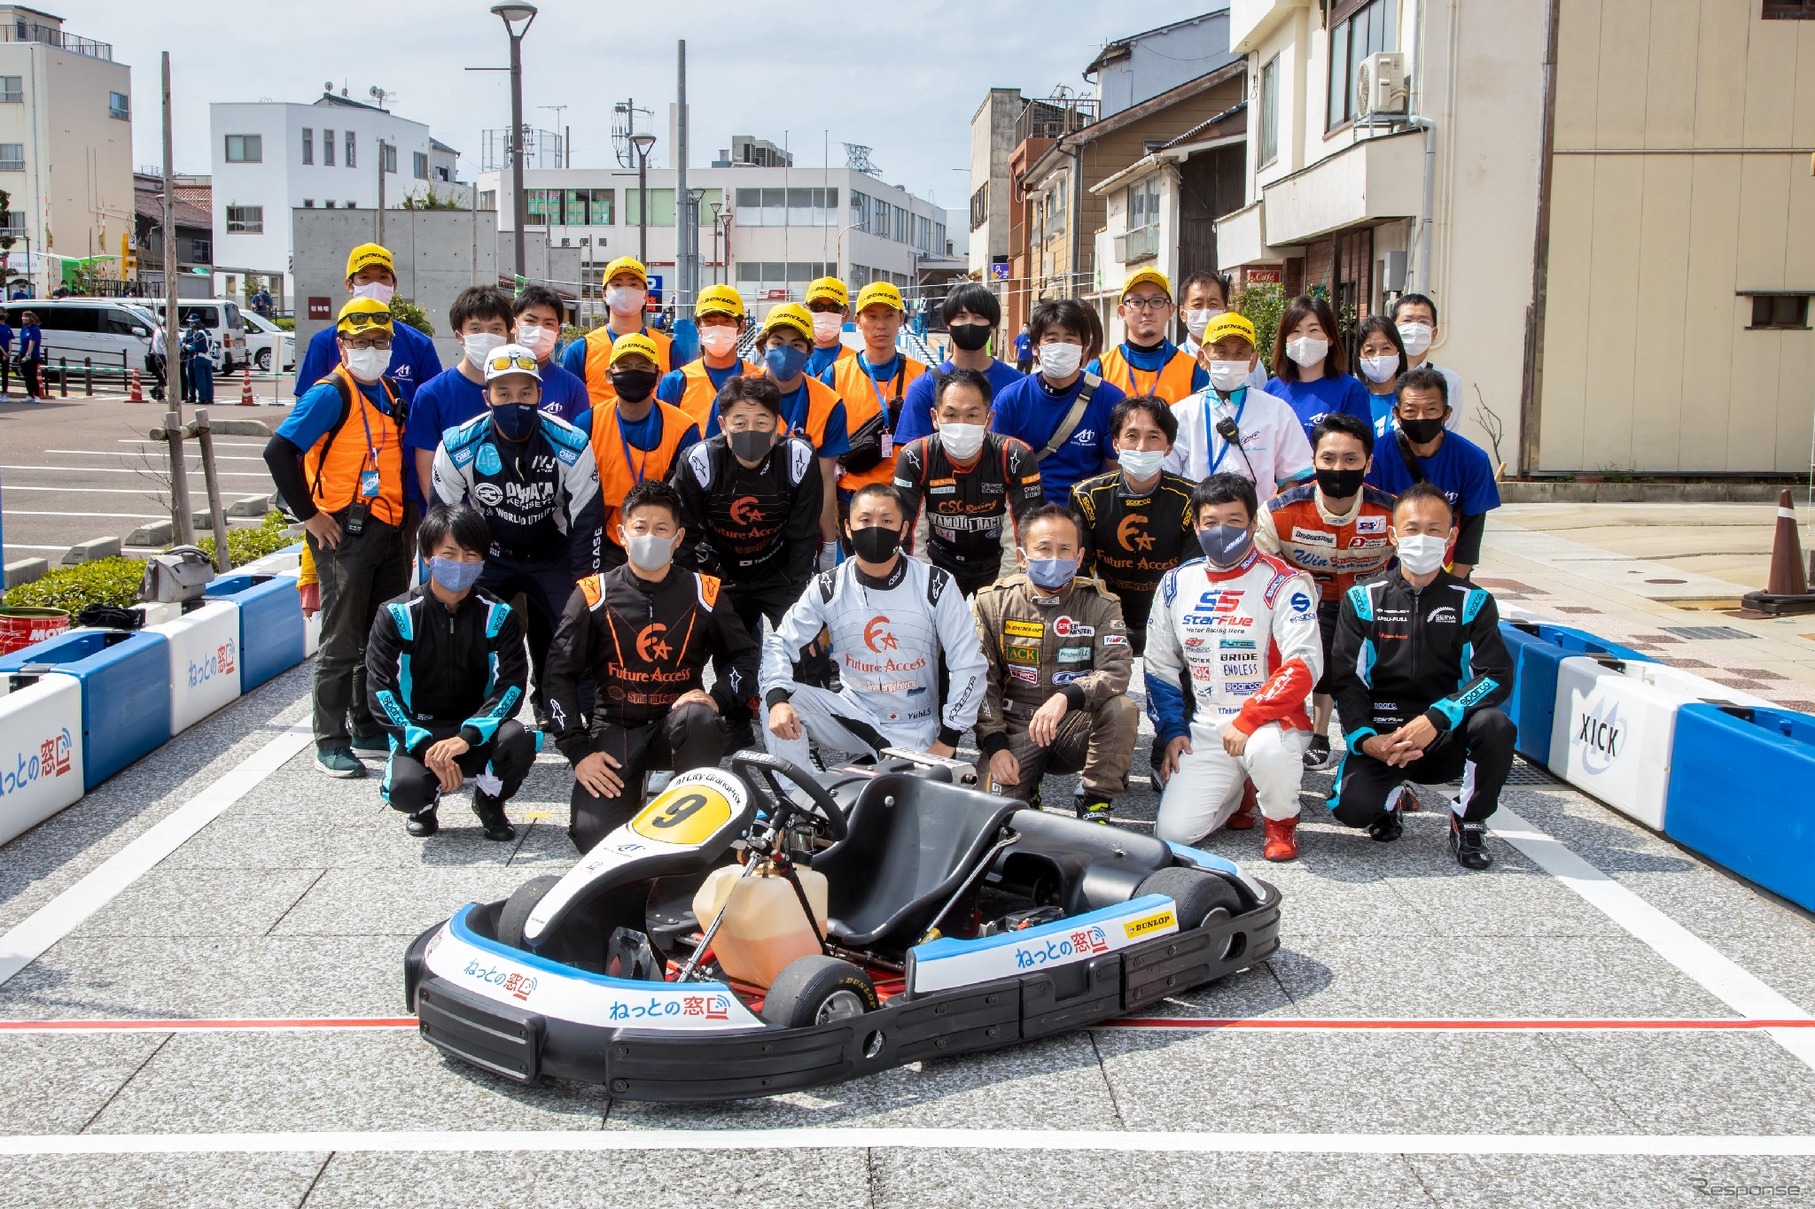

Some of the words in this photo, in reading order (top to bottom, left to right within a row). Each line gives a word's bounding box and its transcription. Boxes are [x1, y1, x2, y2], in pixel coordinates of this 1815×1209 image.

[815, 286, 844, 297] DUNLOP
[867, 292, 898, 301] DUNLOP
[702, 296, 737, 306] DUNLOP
[776, 313, 810, 329] DUNLOP
[1215, 323, 1252, 335] DUNLOP
[620, 343, 656, 355] DUNLOP
[455, 450, 471, 461] OMP
[558, 450, 577, 461] OMP
[938, 500, 964, 513] CSC
[1125, 499, 1152, 507] sparco
[1097, 549, 1134, 569] Future
[1137, 556, 1179, 571] Access
[1293, 549, 1329, 568] Win
[1011, 625, 1043, 633] DUNLOP
[1010, 648, 1036, 661] ACK
[1219, 653, 1259, 662] BRIDE
[845, 652, 883, 673] Future
[884, 656, 927, 673] Access
[608, 662, 650, 683] Future
[651, 667, 691, 682] Access
[1223, 663, 1258, 676] ENDLESS
[1225, 682, 1263, 691] sparco
[1459, 680, 1491, 707] sparco
[492, 690, 517, 719] sparco
[1374, 702, 1398, 711] sparc
[382, 695, 409, 728] sparco
[1579, 713, 1620, 757] XICK
[651, 794, 709, 829] 9
[1135, 915, 1170, 932] DUNLOP
[845, 977, 877, 1010] DUNLOP
